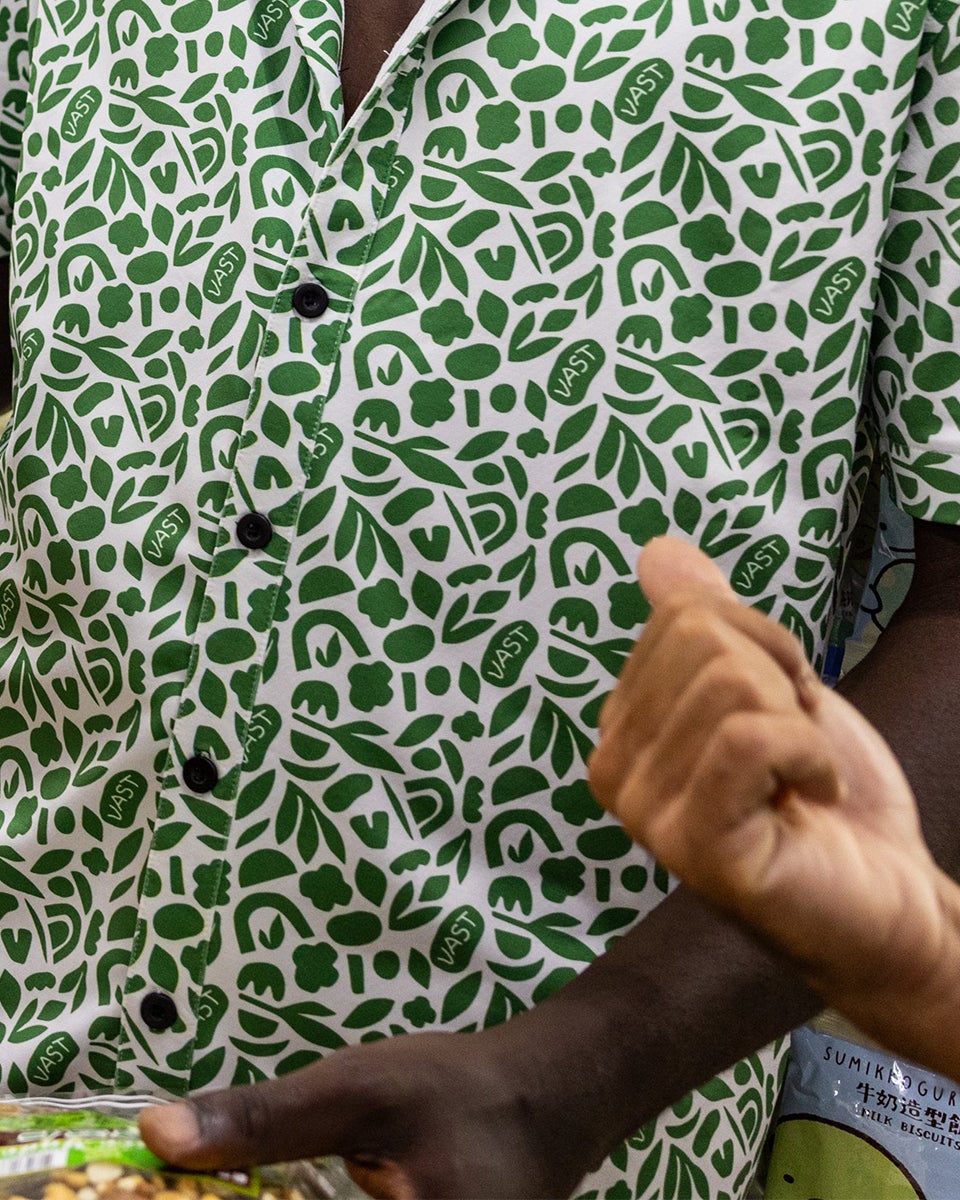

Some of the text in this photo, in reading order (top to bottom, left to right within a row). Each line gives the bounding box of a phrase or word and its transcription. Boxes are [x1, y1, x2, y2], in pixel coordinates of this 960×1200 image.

[64, 92, 98, 138] VAST
[620, 63, 665, 118] VAST
[208, 246, 241, 298] VAST
[815, 261, 860, 318] VAST
[553, 345, 597, 399] VAST
[147, 508, 185, 560] VAST
[736, 540, 782, 590] VAST
[487, 625, 531, 681] VAST
[106, 774, 137, 822] VAST
[437, 911, 478, 966] VAST
[32, 1037, 67, 1084] VAST
[861, 1107, 960, 1150] MILK BISCUITS
